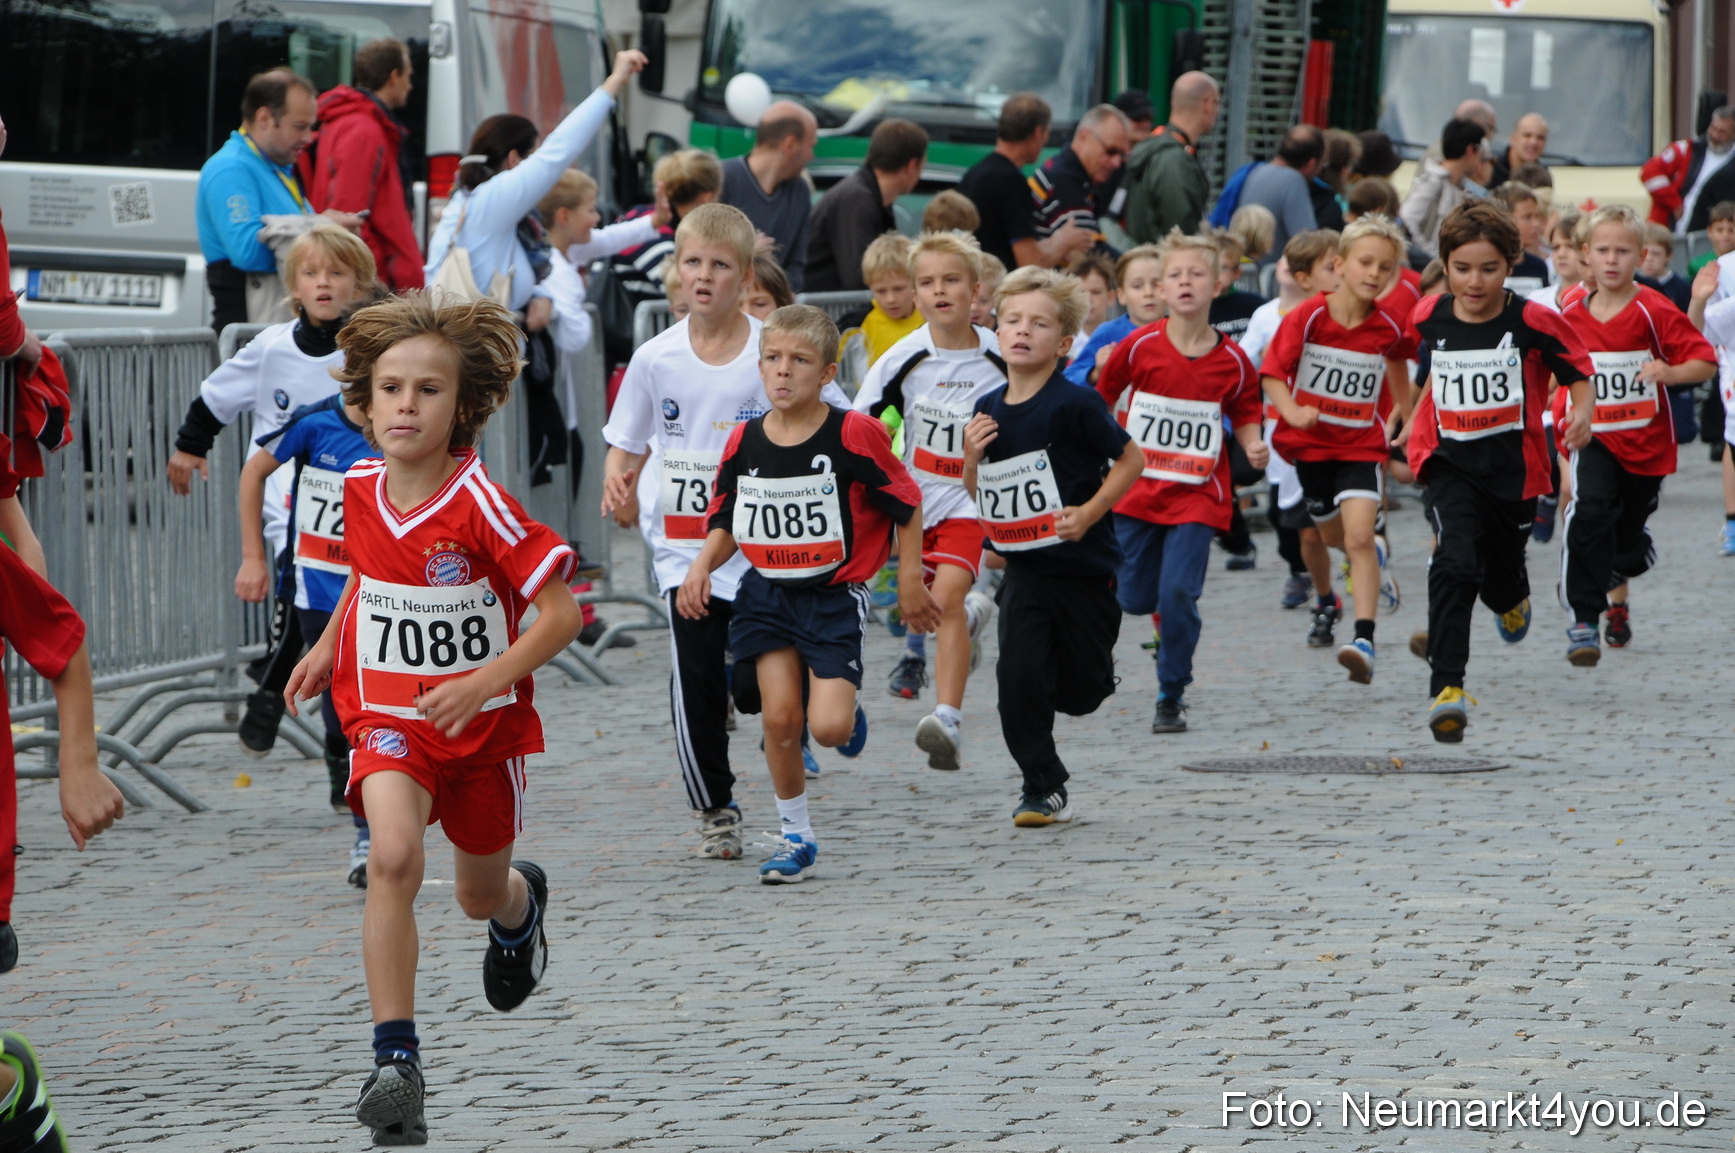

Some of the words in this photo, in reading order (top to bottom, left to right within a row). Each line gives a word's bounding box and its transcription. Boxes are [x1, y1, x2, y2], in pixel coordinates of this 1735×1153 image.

[41, 275, 66, 295] NM
[80, 277, 104, 296] YV
[109, 278, 158, 299] 1111
[1335, 357, 1376, 369] Neumarkt
[1455, 360, 1503, 369] Neumarkt
[1597, 360, 1639, 369] Neumarkt
[1309, 363, 1377, 398] 7089
[1439, 371, 1509, 405] 7103
[914, 403, 944, 418] PARTL
[1134, 400, 1162, 413] PARTL
[1164, 406, 1209, 419] Neumarkt
[1318, 400, 1354, 417] Lukas
[1597, 409, 1627, 420] Luca
[1457, 414, 1488, 428] Nino
[922, 418, 967, 452] 71
[1140, 414, 1211, 451] 7090
[664, 460, 691, 470] PARTL
[1147, 452, 1195, 472] Vincent
[982, 465, 1031, 482] Neumarkt
[302, 476, 336, 493] PARTL
[740, 486, 762, 498] PARTL
[764, 487, 817, 499] Neumarkt
[671, 478, 717, 513] 73
[744, 501, 828, 539] 7085
[991, 524, 1038, 540] Tommy
[438, 555, 465, 567] BAYERN
[766, 549, 810, 565] Kilian
[361, 591, 399, 610] PARTL
[403, 598, 477, 613] Neumarkt
[370, 614, 490, 667] 7088
